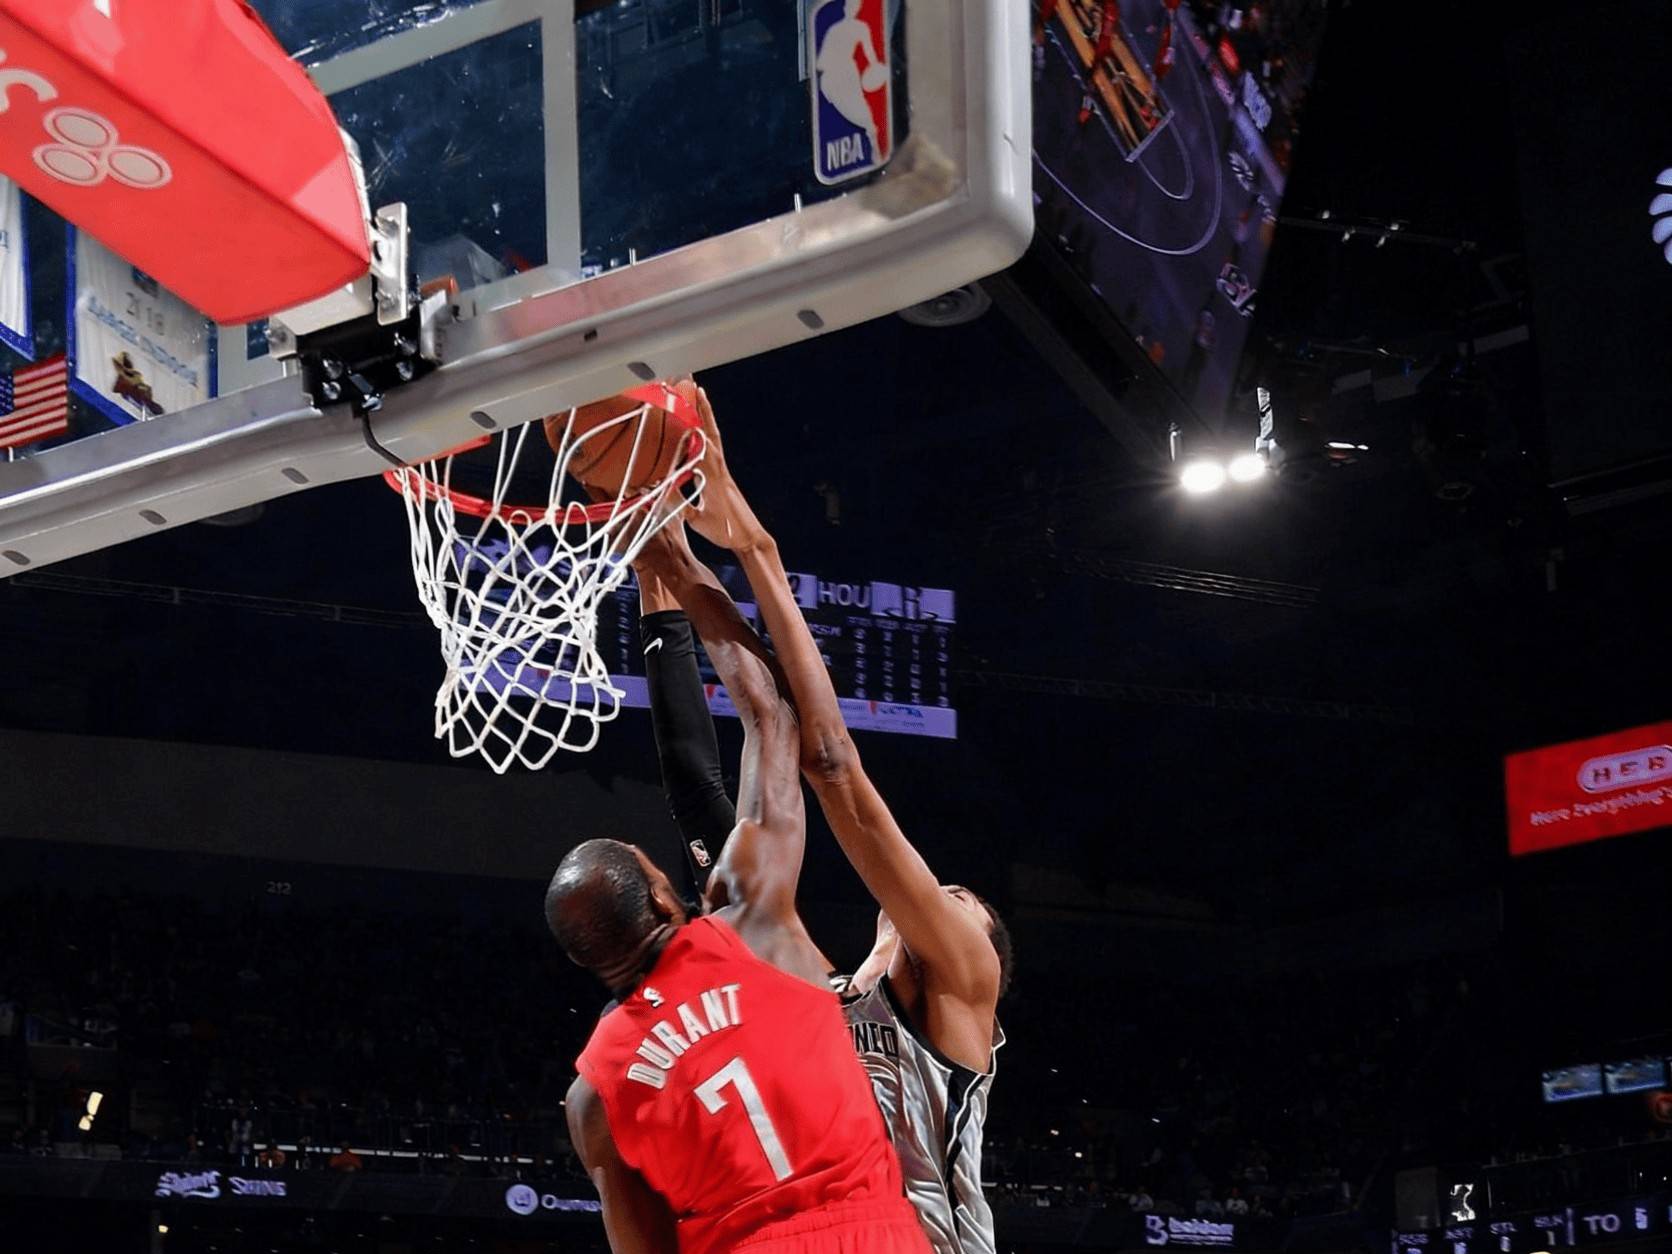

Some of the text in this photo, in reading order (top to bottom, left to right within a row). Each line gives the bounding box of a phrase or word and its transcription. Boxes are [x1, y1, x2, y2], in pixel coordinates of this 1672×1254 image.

[826, 132, 865, 172] NBA
[818, 580, 871, 609] HOU
[626, 983, 743, 1091] DURANT
[693, 1056, 794, 1183] 7
[1582, 1212, 1622, 1236] TO
